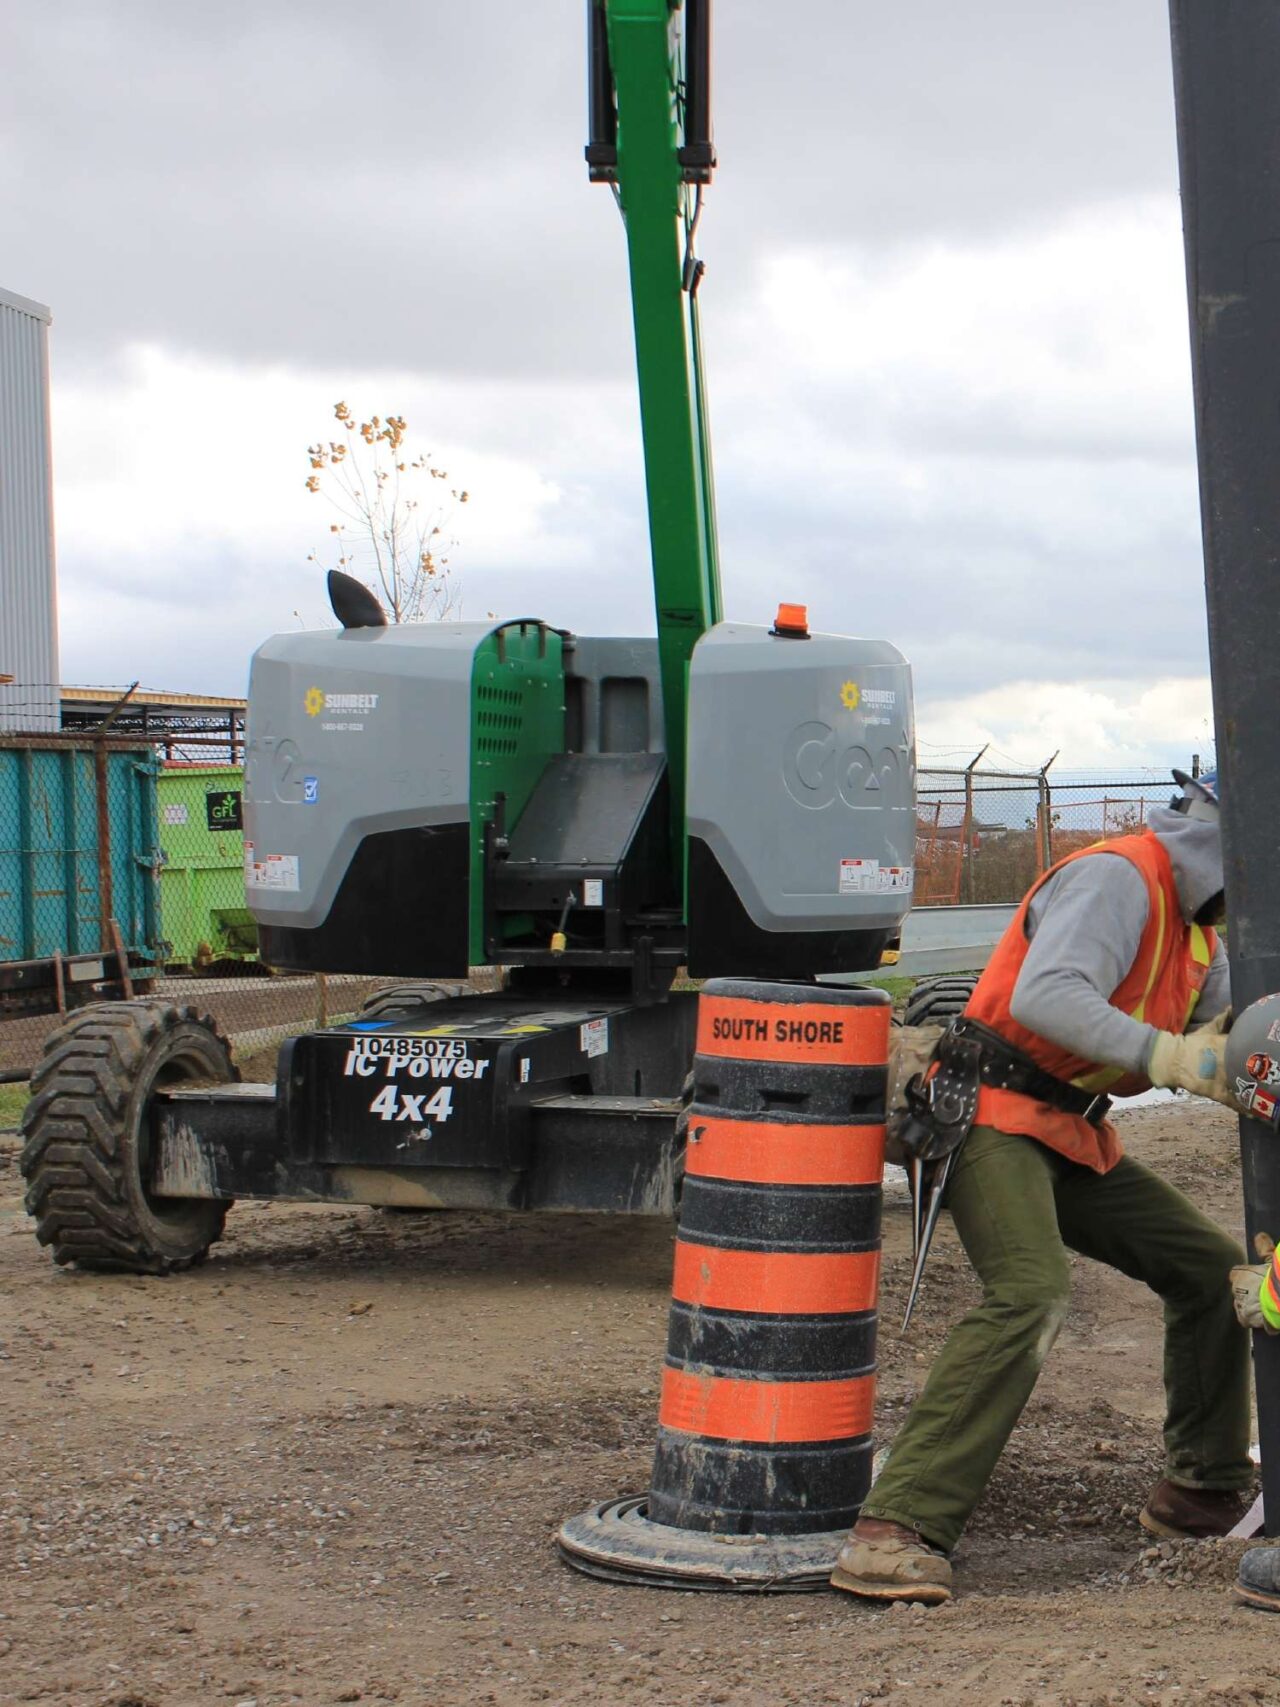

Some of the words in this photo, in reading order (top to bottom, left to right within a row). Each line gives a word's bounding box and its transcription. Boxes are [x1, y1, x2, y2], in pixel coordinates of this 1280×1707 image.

[325, 694, 379, 708] SUNBELT
[211, 805, 237, 819] GFL
[713, 1018, 768, 1042] SOUTH
[775, 1020, 844, 1044] SHORE
[356, 1038, 465, 1058] 10485075
[344, 1052, 378, 1077] IC
[386, 1055, 490, 1080] Power
[370, 1085, 453, 1123] 4x4
